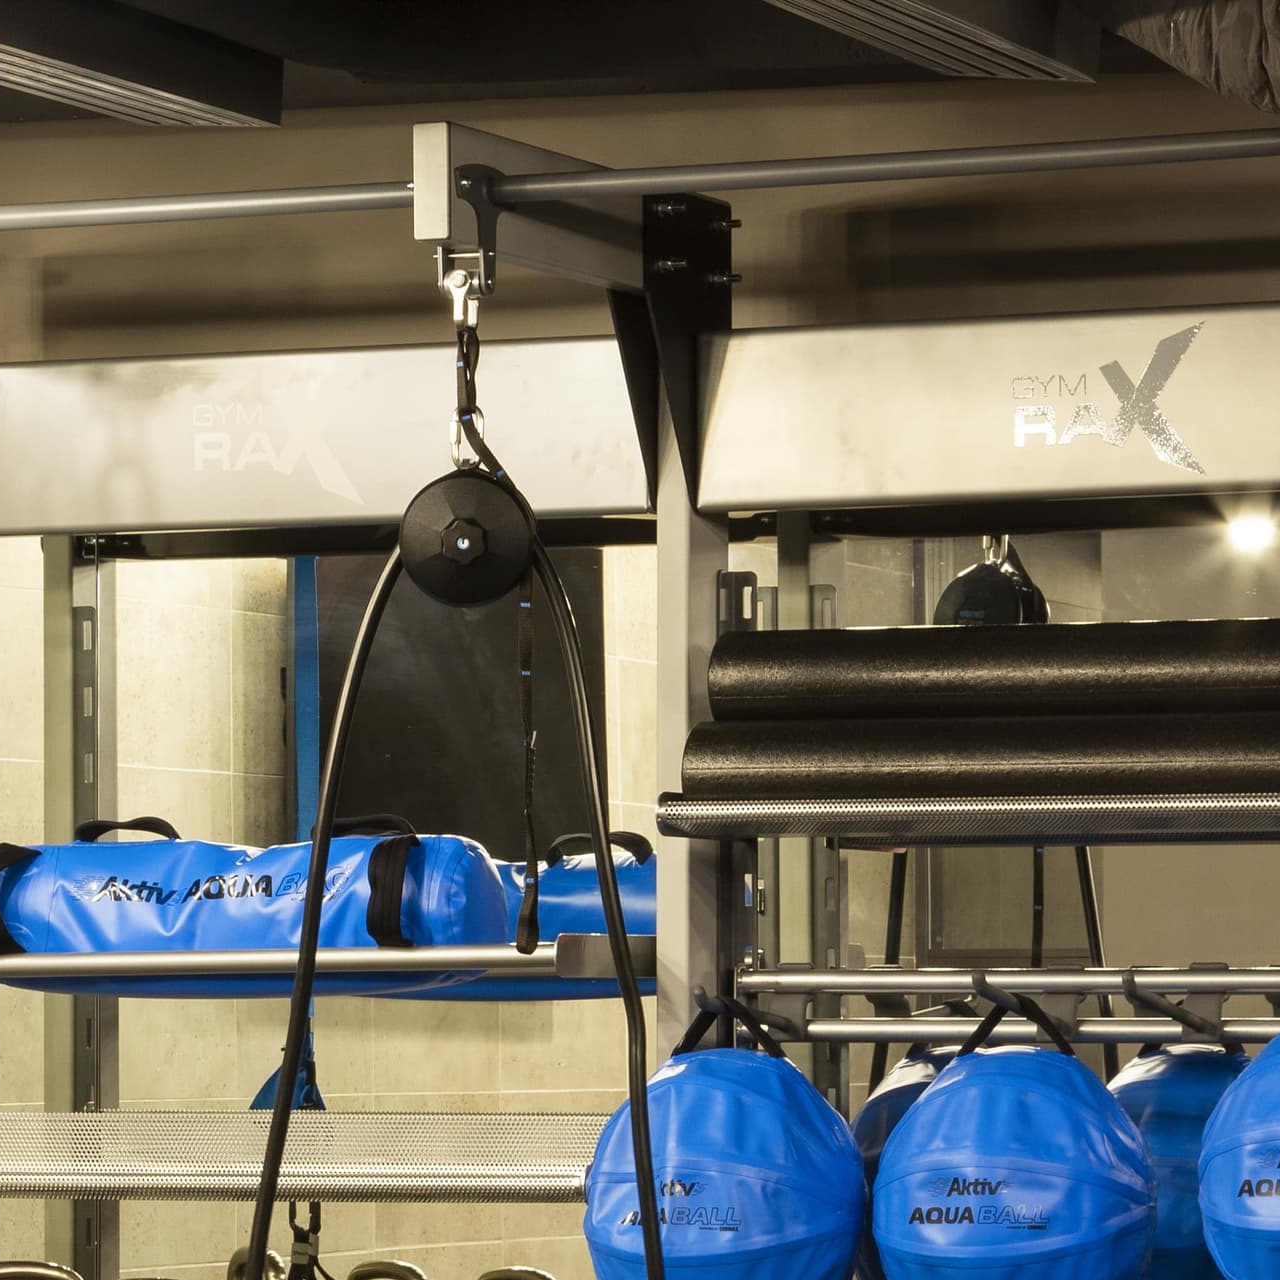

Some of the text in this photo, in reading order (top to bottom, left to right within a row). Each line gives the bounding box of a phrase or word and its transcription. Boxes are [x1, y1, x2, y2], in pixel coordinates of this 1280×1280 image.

[1012, 374, 1087, 399] GYM
[1013, 320, 1206, 476] RAX
[181, 874, 273, 904] AQUA
[946, 1176, 1002, 1198] Aktiv
[670, 1206, 742, 1226] BALL
[908, 1205, 1050, 1225] AQUA BALL
